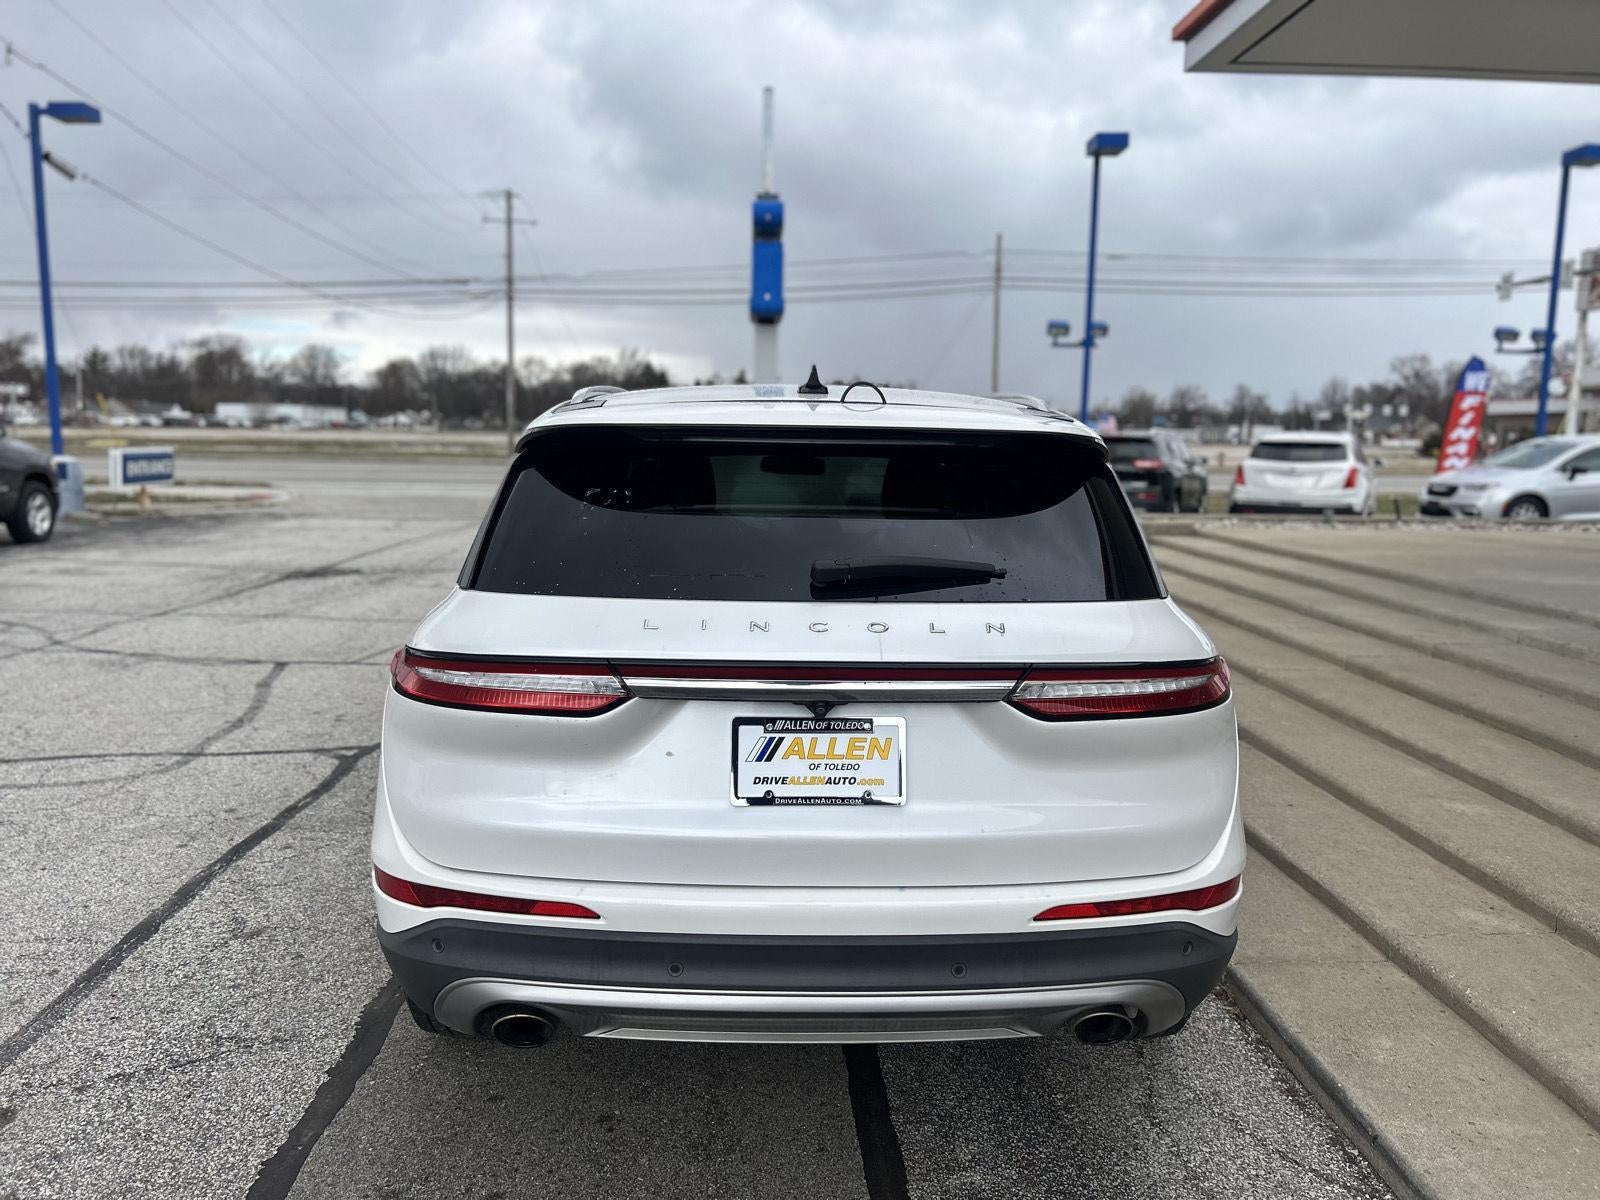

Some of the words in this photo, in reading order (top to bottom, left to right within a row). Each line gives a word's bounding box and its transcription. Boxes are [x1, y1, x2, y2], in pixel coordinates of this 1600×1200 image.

[643, 618, 1006, 634] LINCOLN
[783, 720, 815, 730] ALLEN
[815, 721, 828, 730] OF
[830, 721, 864, 730] TOLEDO
[781, 736, 893, 761] ALLEN
[808, 763, 821, 771] OF
[824, 763, 861, 771] TOLEDO
